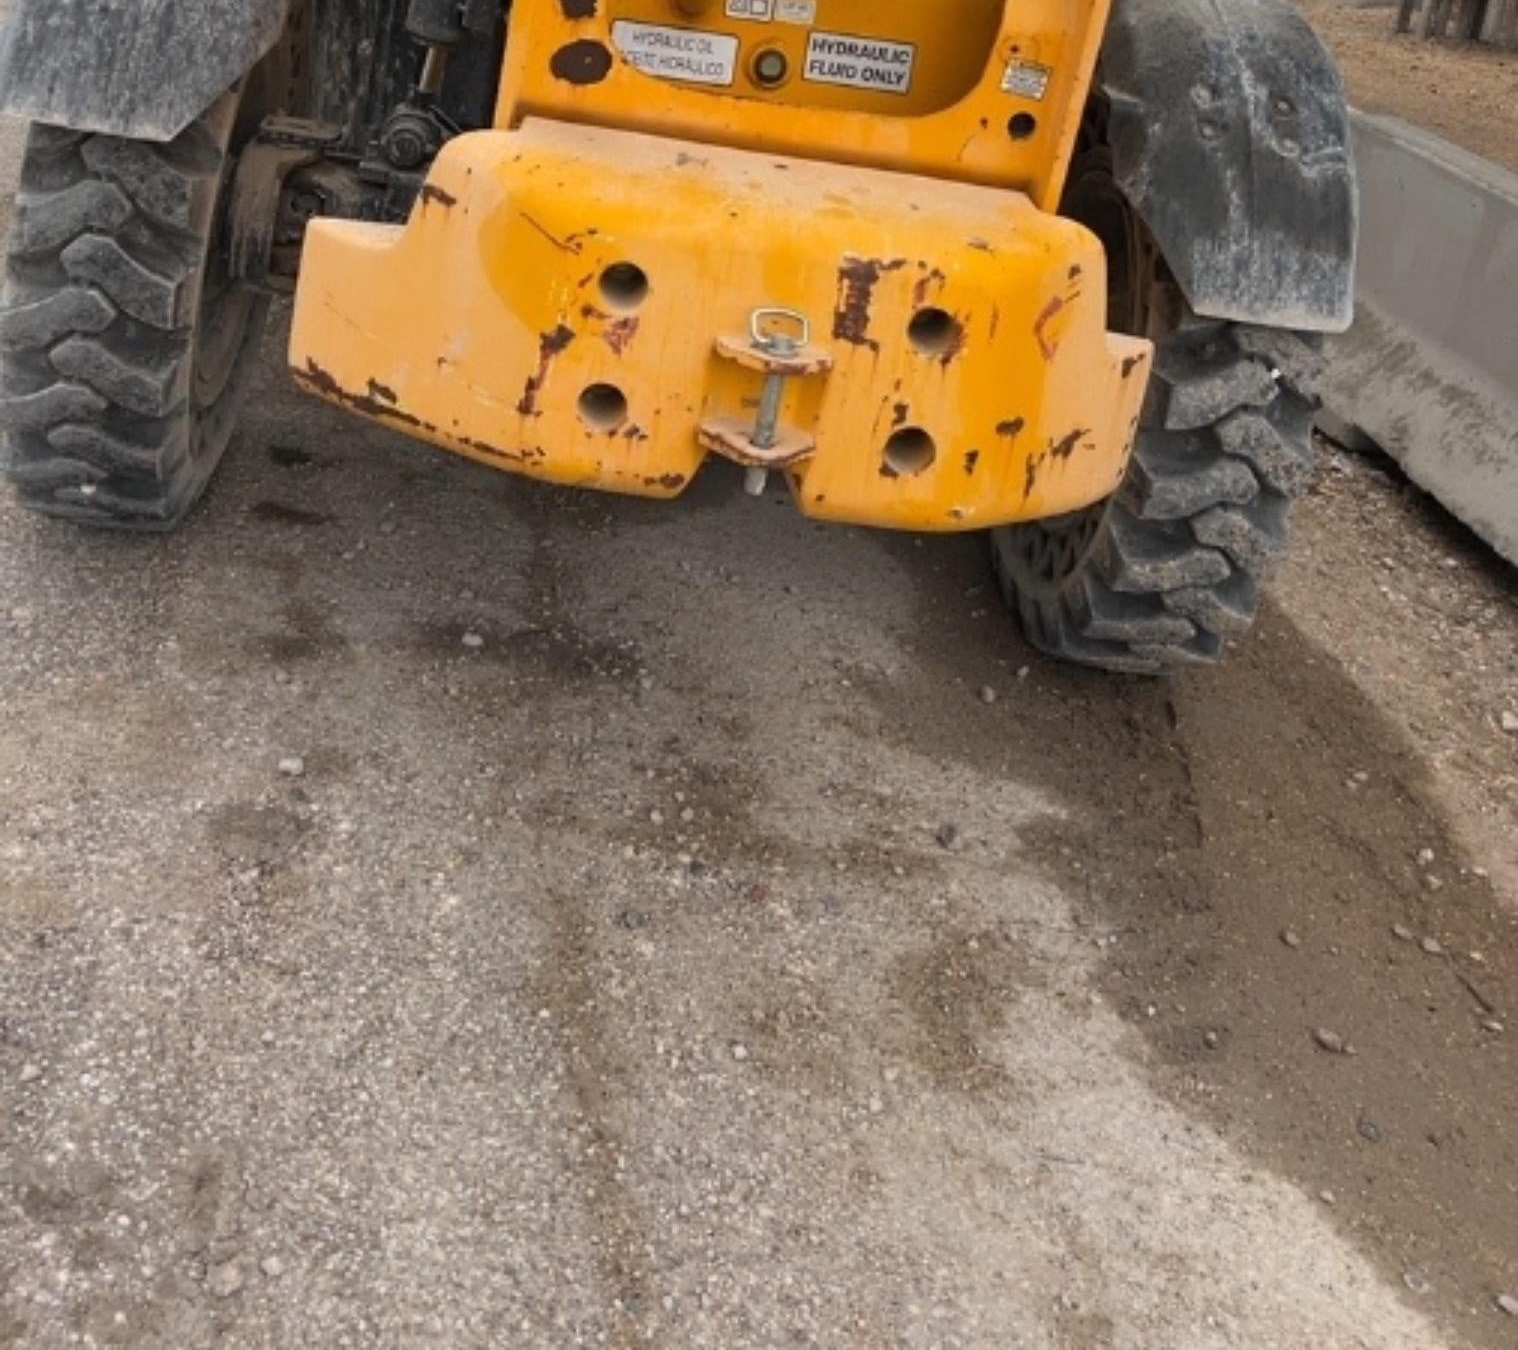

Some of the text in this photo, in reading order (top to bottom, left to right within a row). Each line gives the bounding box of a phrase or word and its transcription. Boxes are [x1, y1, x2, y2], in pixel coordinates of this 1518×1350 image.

[812, 38, 910, 64] HYDRAULIC
[809, 59, 906, 85] FLUID ONLY
